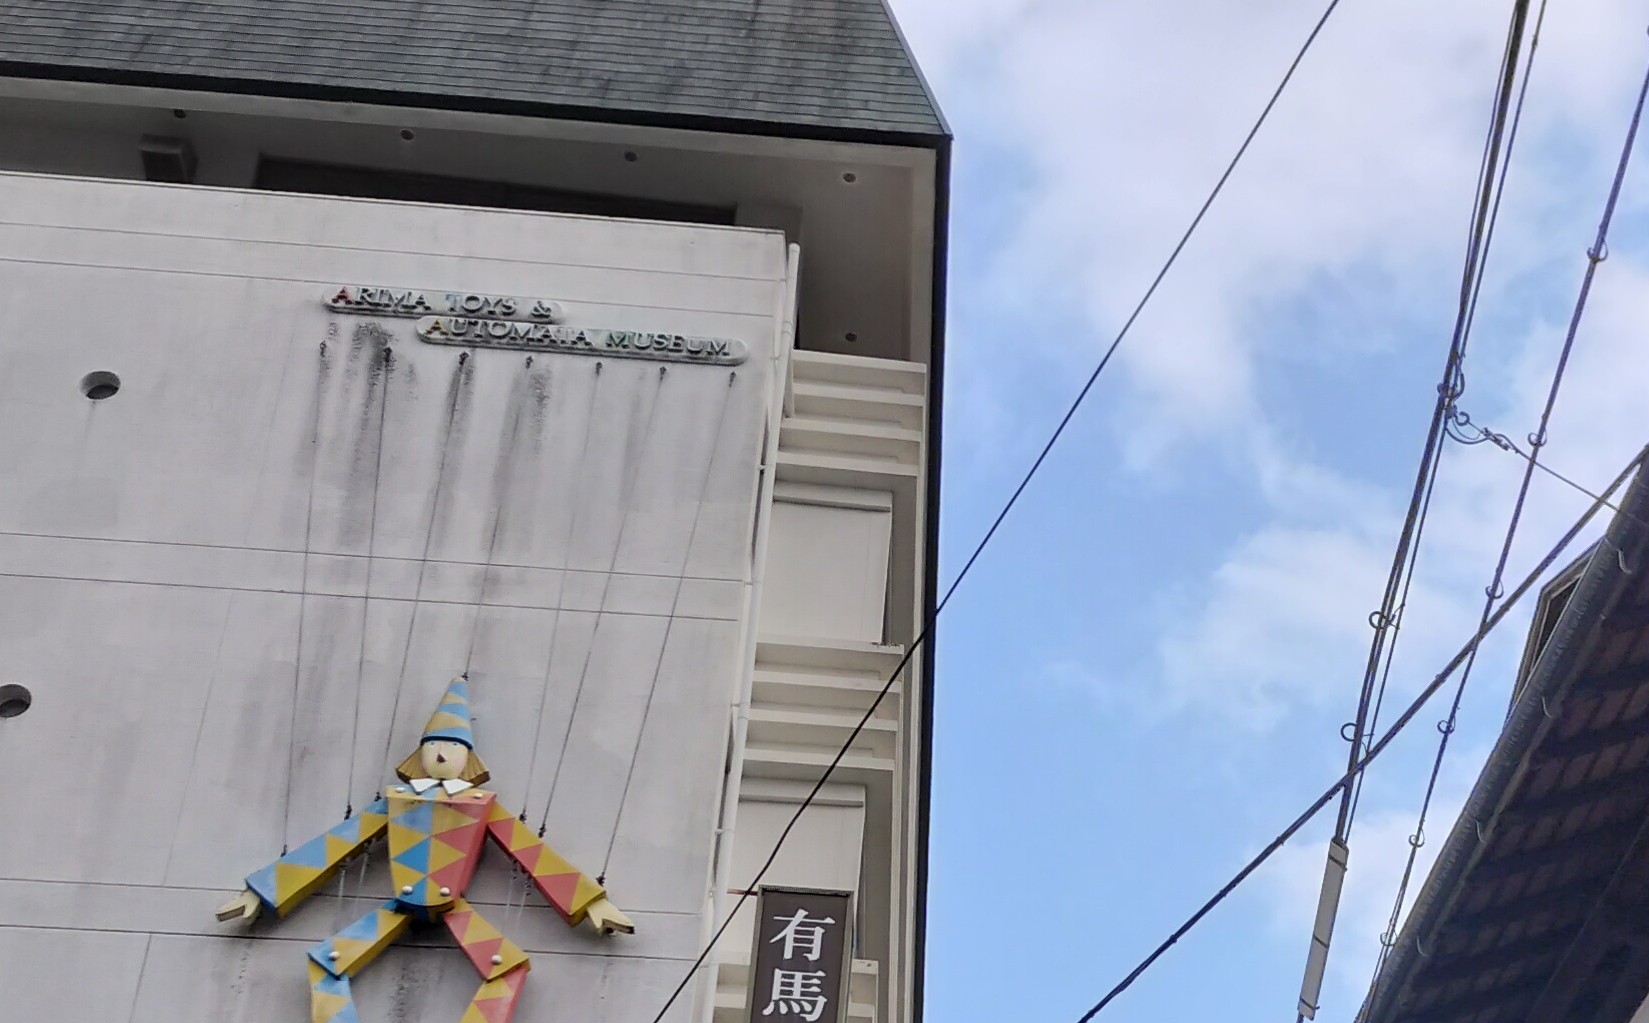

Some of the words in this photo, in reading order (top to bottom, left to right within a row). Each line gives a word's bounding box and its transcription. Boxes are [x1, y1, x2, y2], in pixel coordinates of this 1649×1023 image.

[331, 286, 431, 311] ARIMA
[445, 293, 517, 316] TOYS
[531, 299, 553, 318] &
[425, 317, 595, 347] AUTOMATA
[605, 331, 731, 356] MUSEUM
